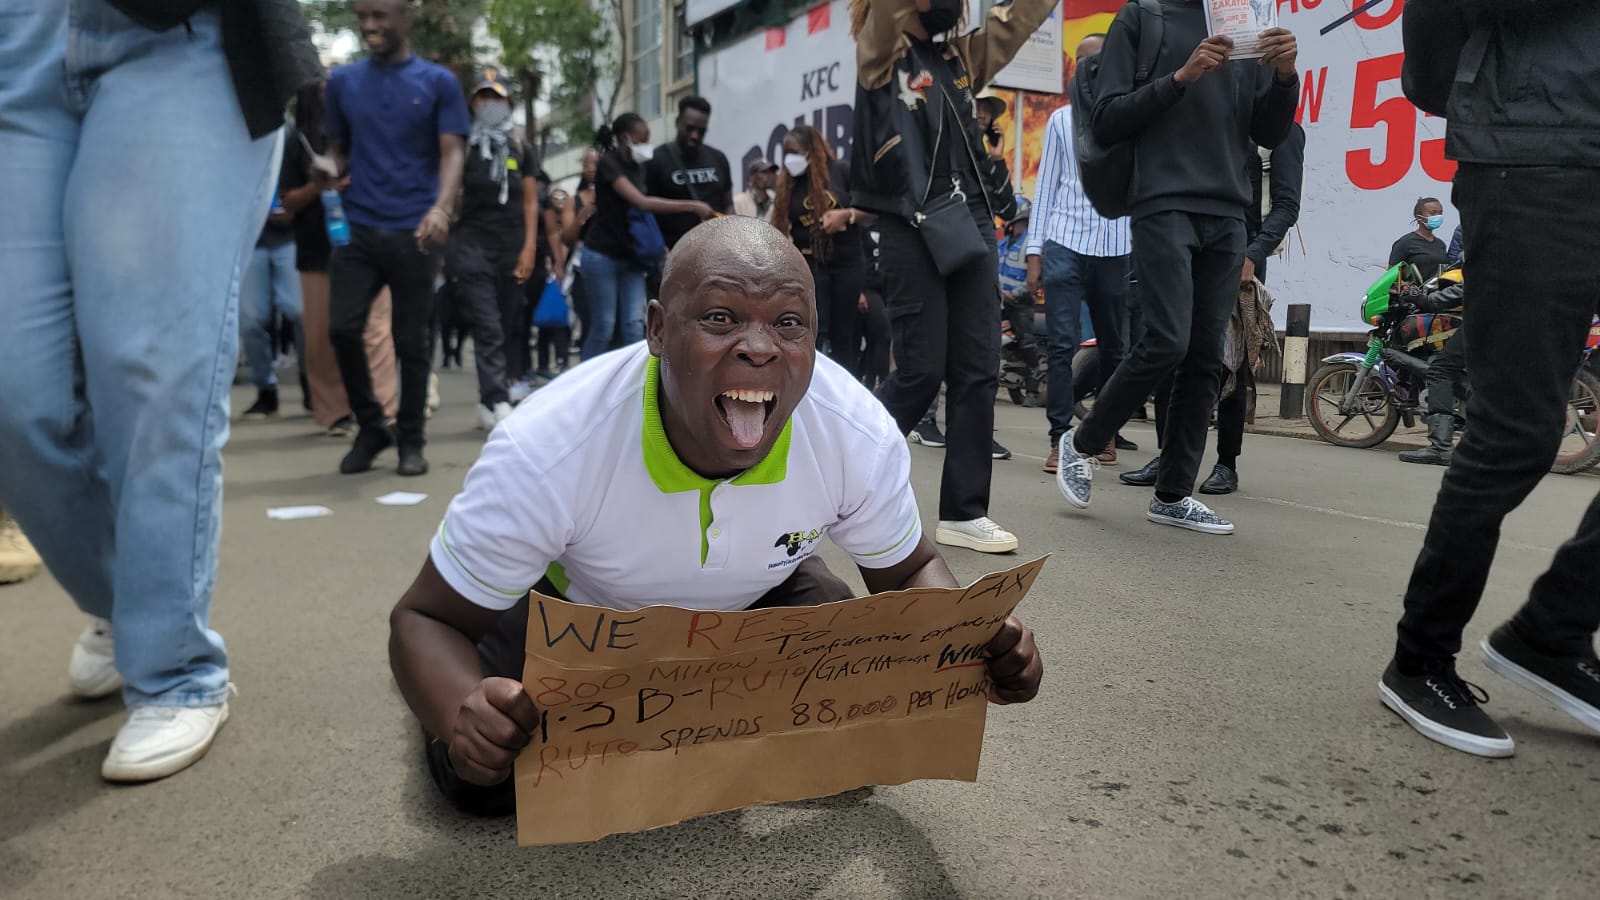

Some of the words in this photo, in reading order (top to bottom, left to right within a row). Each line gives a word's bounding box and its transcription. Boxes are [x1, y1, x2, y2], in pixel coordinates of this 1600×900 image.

[801, 61, 841, 101] KFC
[537, 600, 646, 653] WE
[686, 590, 951, 651] RESIST
[955, 566, 1035, 605] TAX
[536, 672, 631, 707] 800
[532, 739, 640, 789] RUTO
[648, 715, 764, 756] SPENDS
[790, 695, 897, 730] 88,000
[541, 699, 616, 744] 1.3
